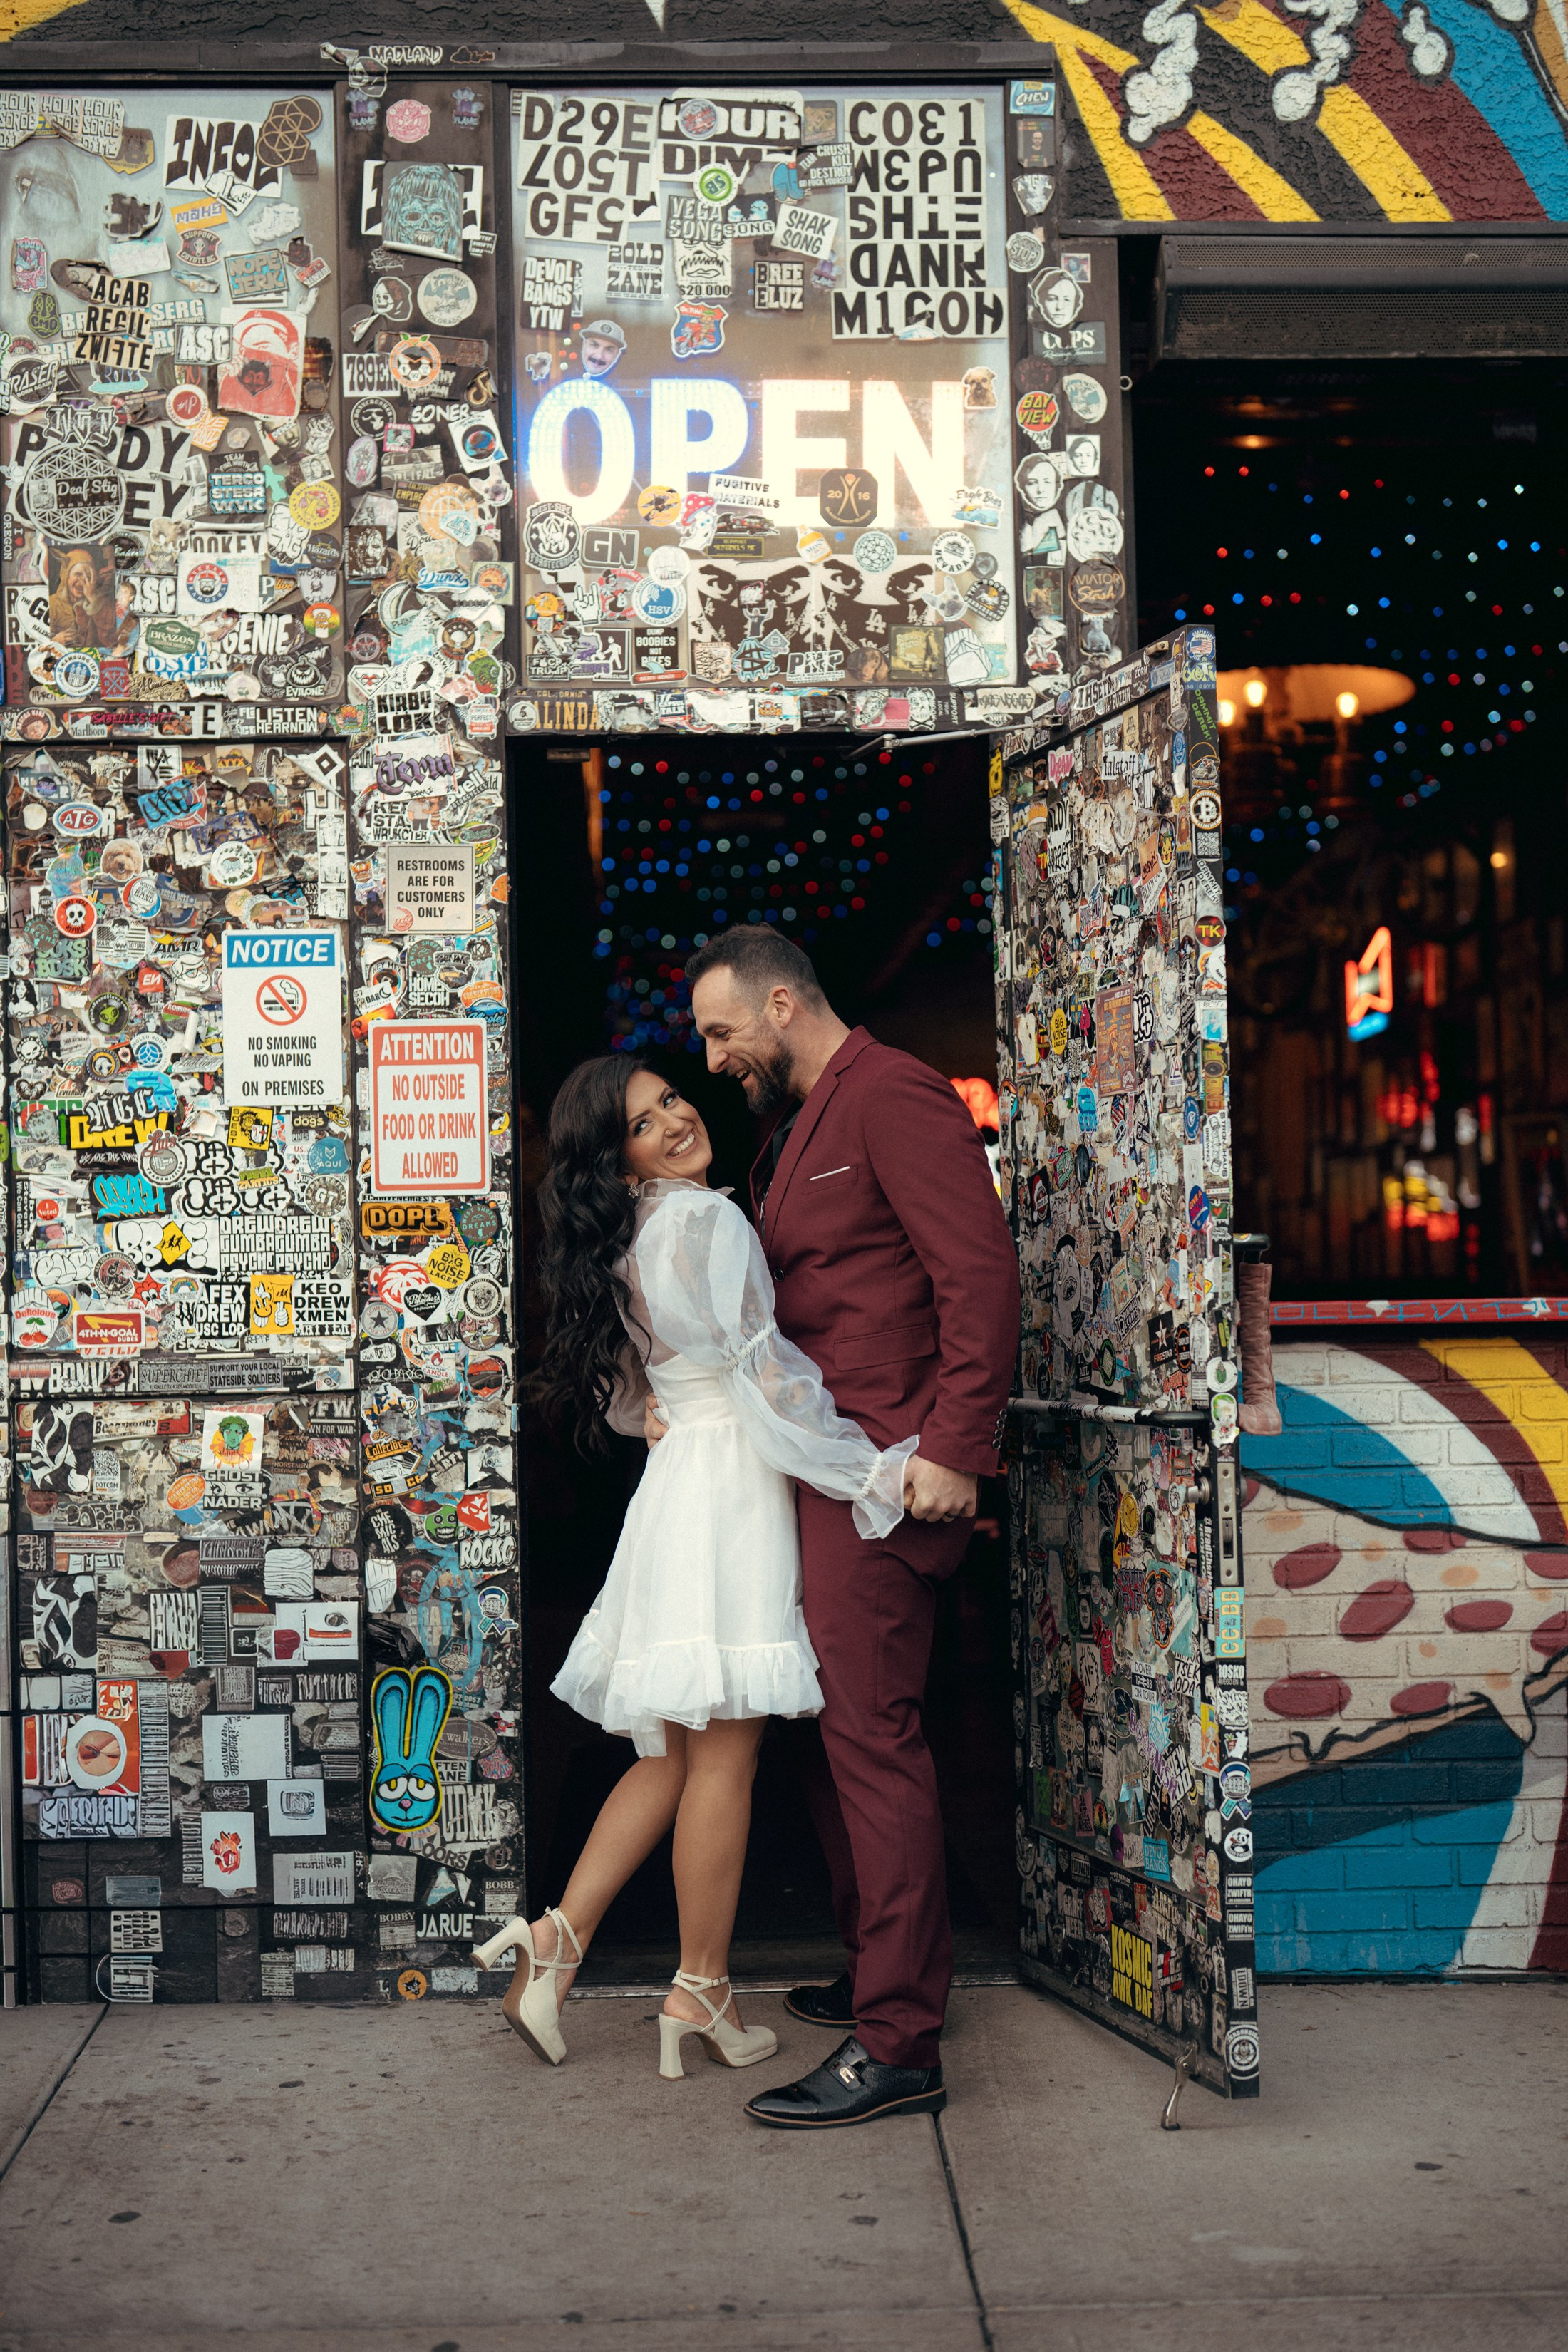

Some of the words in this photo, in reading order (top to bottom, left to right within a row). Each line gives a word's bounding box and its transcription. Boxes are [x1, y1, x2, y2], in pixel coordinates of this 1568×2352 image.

[370, 46, 443, 65] MADLAND
[817, 145, 851, 156] CRUSH
[831, 155, 852, 166] KILL
[810, 166, 853, 179] DESTROY
[723, 221, 774, 237] SONG
[785, 209, 831, 236] SHAK
[669, 219, 723, 242] SONG
[780, 232, 822, 255] SONG
[229, 252, 281, 277] NOPE
[232, 269, 284, 294] JERK
[523, 282, 572, 306] BANGS
[425, 311, 461, 324] COLORADO
[1021, 395, 1053, 408] BAY
[1018, 409, 1057, 425] VIEW
[528, 378, 964, 528] OPEN
[56, 479, 90, 496] Deaf
[91, 478, 119, 499] Stig
[715, 477, 770, 493] FUGITIVE
[857, 491, 870, 500] 16
[1, 513, 13, 560] OREGON
[585, 530, 636, 567] GN
[934, 548, 970, 572] NEVADA
[1073, 573, 1121, 585] AVIATOR
[1078, 586, 1116, 603] Stash
[646, 604, 672, 616] HSV
[150, 630, 195, 645] BRAZOS
[636, 636, 676, 646] BOOBIES
[257, 708, 318, 723] LISTEN
[659, 706, 685, 715] TALK
[949, 691, 958, 725] SUPPORT
[1195, 688, 1217, 730] DAMMIT
[91, 713, 145, 724] ISABELLE'S
[1191, 702, 1212, 741] DEREK!
[72, 726, 105, 737] Marlboro
[256, 722, 318, 733] HEARNOW
[62, 811, 95, 827] ATG
[397, 860, 465, 871] RESTROOMS
[408, 876, 430, 887] ARE
[433, 876, 454, 887] FOR
[1198, 860, 1222, 894] DAMMIT
[1197, 873, 1219, 904] DEREK!
[397, 891, 465, 902] CUSTOMERS
[418, 907, 445, 918] ONLY
[1198, 924, 1222, 938] TK
[232, 939, 330, 963] NOTICE
[1051, 1028, 1067, 1039] NOISE
[248, 1037, 263, 1050] NO
[266, 1036, 316, 1050] SMOKING
[381, 1032, 474, 1061] ATTENTION
[254, 1054, 269, 1068] NO
[272, 1053, 311, 1068] VAPING
[242, 1082, 259, 1096] ON
[264, 1080, 324, 1095] PREMISES
[393, 1074, 410, 1101] NO
[413, 1073, 465, 1101] OUTSIDE
[294, 1118, 324, 1128] dogs
[383, 1113, 416, 1140] FOOD
[419, 1113, 435, 1140] OR
[439, 1113, 476, 1139] DRINK
[402, 1151, 458, 1179] ALLOWED
[314, 1187, 339, 1206] GT
[221, 1215, 274, 1233] DREW
[275, 1216, 330, 1233] DREW
[462, 1220, 497, 1230] DREAMS
[441, 1252, 463, 1268] BIG
[429, 1259, 465, 1279] NOISE
[430, 1272, 458, 1286] LAGER
[301, 1283, 342, 1294] KEO
[294, 1296, 350, 1309] DREW
[15, 1309, 56, 1319] Delicious
[196, 1304, 246, 1322] DREW
[295, 1310, 348, 1321] XMEN
[78, 1328, 138, 1338] 4TH-N-GOAL
[240, 1363, 259, 1371] YOUR
[141, 1368, 208, 1383] SUPERCHIEF
[210, 1374, 245, 1386] STATESIDE
[247, 1373, 281, 1385] SOLDIERS
[321, 1425, 336, 1434] FOR
[337, 1424, 354, 1434] WAR
[205, 1470, 262, 1481] GHOST
[203, 1497, 262, 1509] NADER
[1135, 1663, 1152, 1675] DOVER
[1142, 1690, 1155, 1702] TOUR
[445, 1731, 490, 1746] walker's
[1145, 1859, 1167, 1873] BANGS
[1227, 1877, 1252, 1887] OHAYO
[379, 1912, 416, 1922] BOBBY
[1228, 1912, 1253, 1923] OHAYO
[416, 1913, 473, 1938] JARUE
[1112, 1924, 1153, 1989] KOSMIC
[1113, 1969, 1133, 2007] AWK
[1135, 1983, 1153, 2019] DAF
